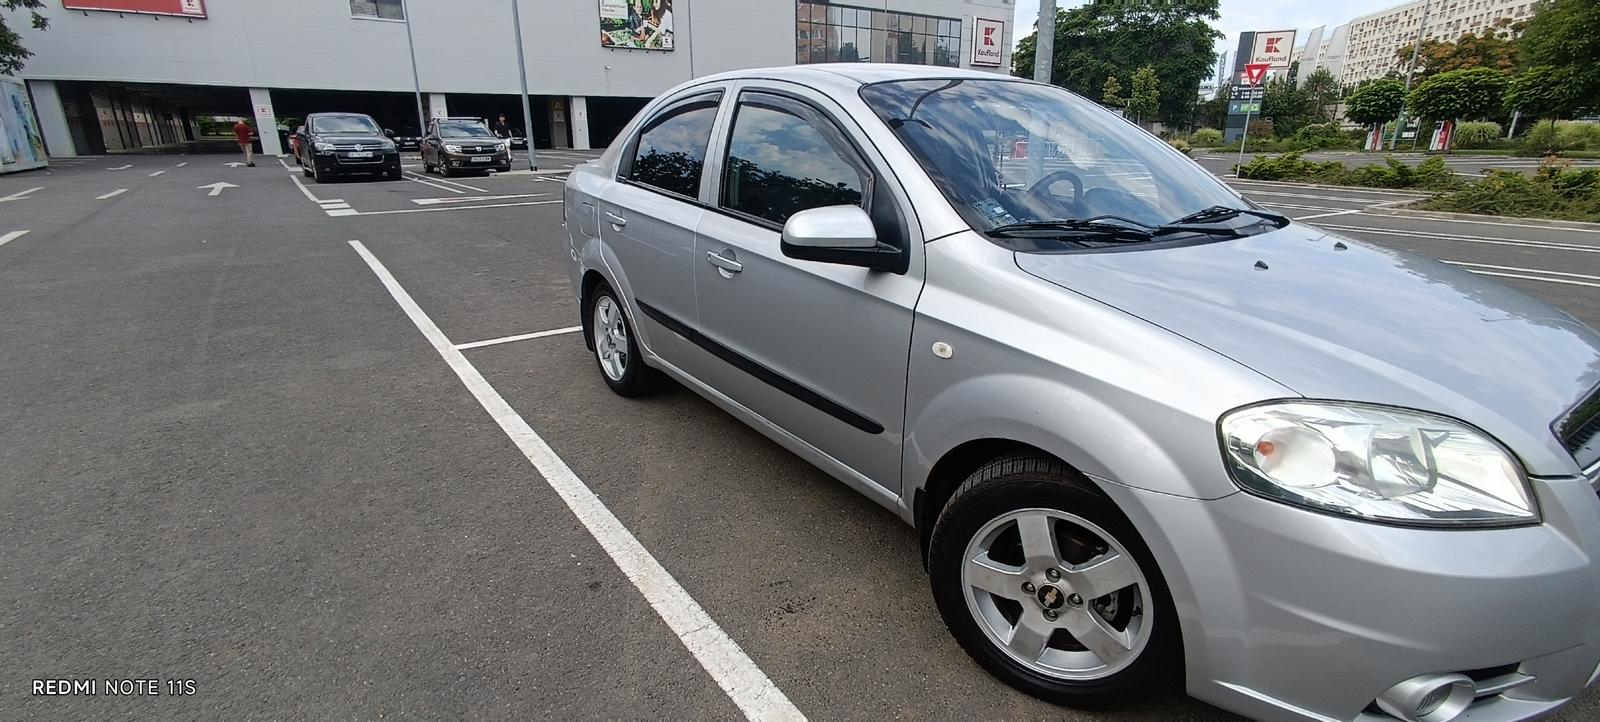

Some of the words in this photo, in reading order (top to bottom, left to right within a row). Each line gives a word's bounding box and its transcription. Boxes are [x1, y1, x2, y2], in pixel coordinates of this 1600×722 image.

[984, 27, 996, 46] K
[1265, 37, 1283, 53] K
[978, 49, 999, 57] Kaufland
[1256, 55, 1287, 63] Kaufland
